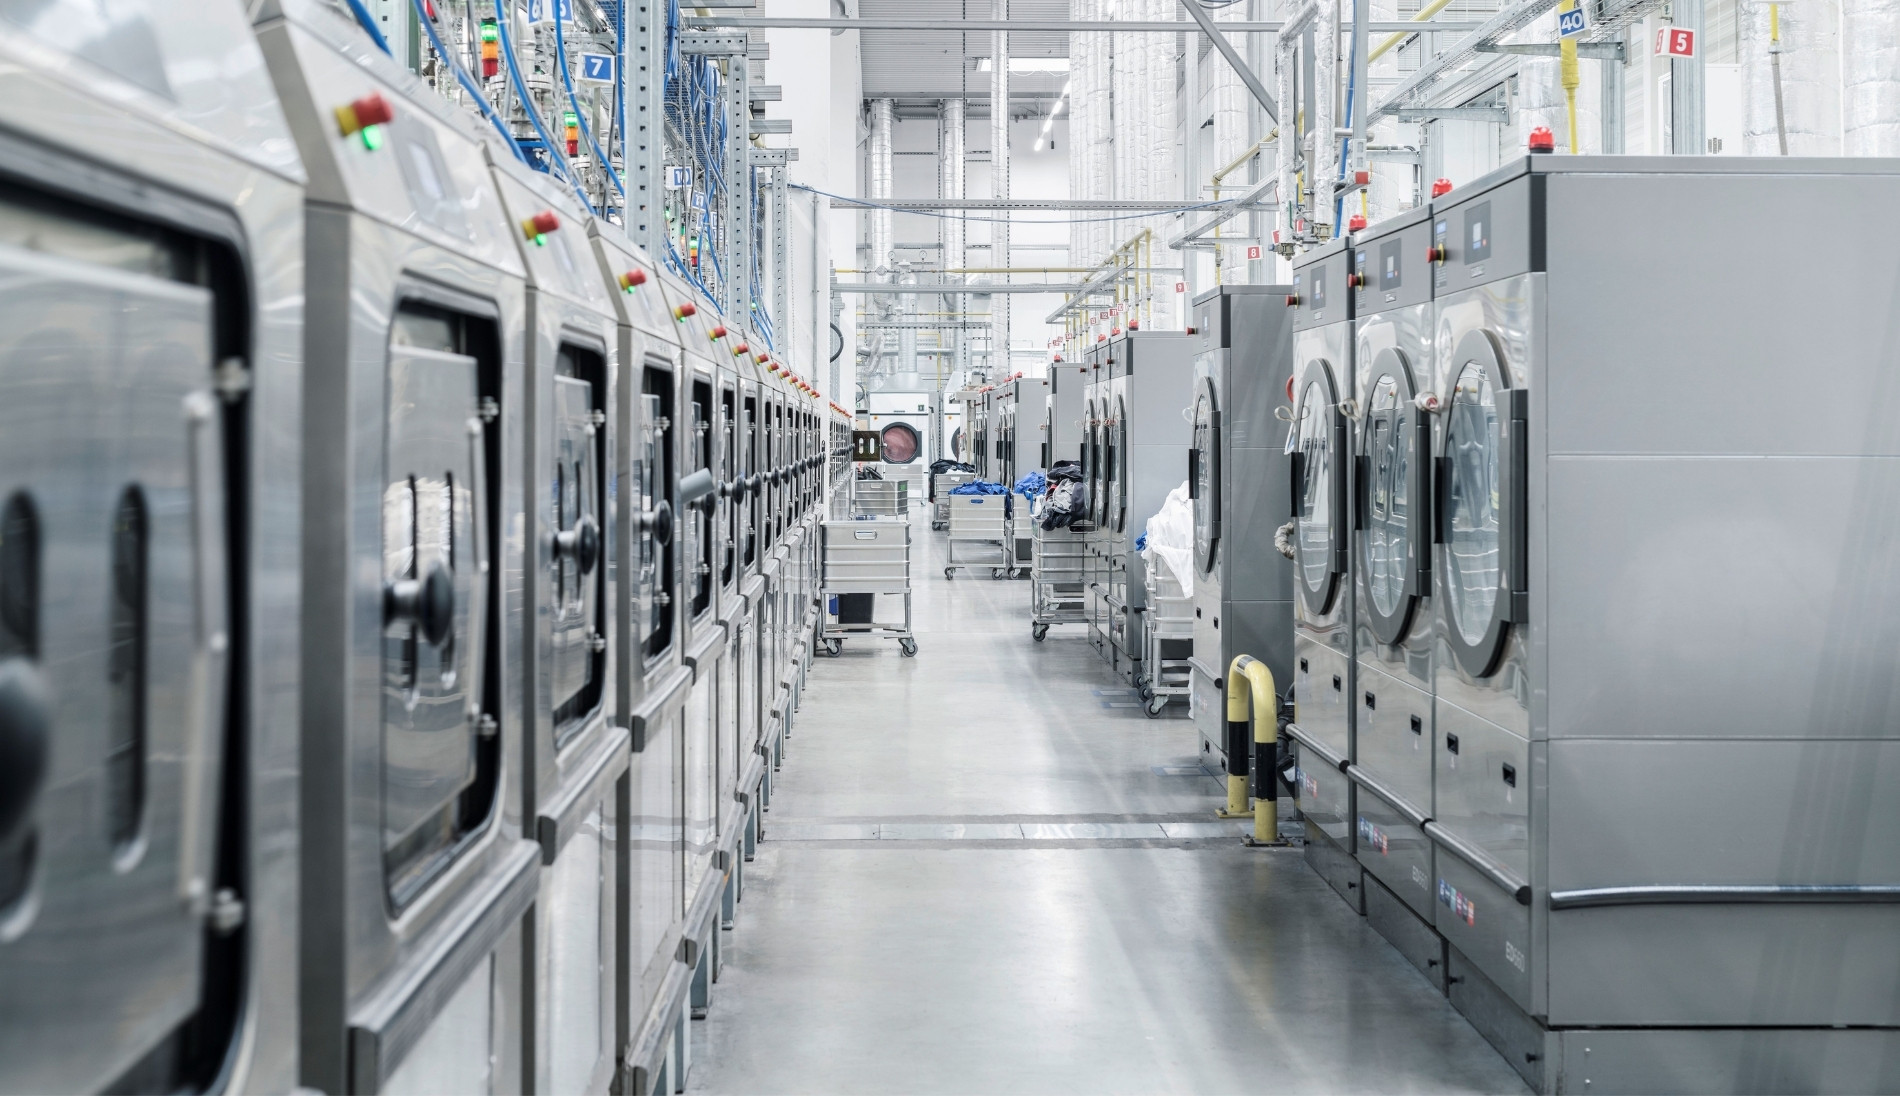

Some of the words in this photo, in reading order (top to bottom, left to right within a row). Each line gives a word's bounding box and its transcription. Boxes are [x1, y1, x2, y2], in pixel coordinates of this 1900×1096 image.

[1561, 12, 1583, 31] 40
[1676, 33, 1687, 52] 5
[591, 58, 603, 76] 7
[675, 170, 690, 185] 10
[1251, 248, 1257, 257] 8
[1177, 283, 1183, 292] 9
